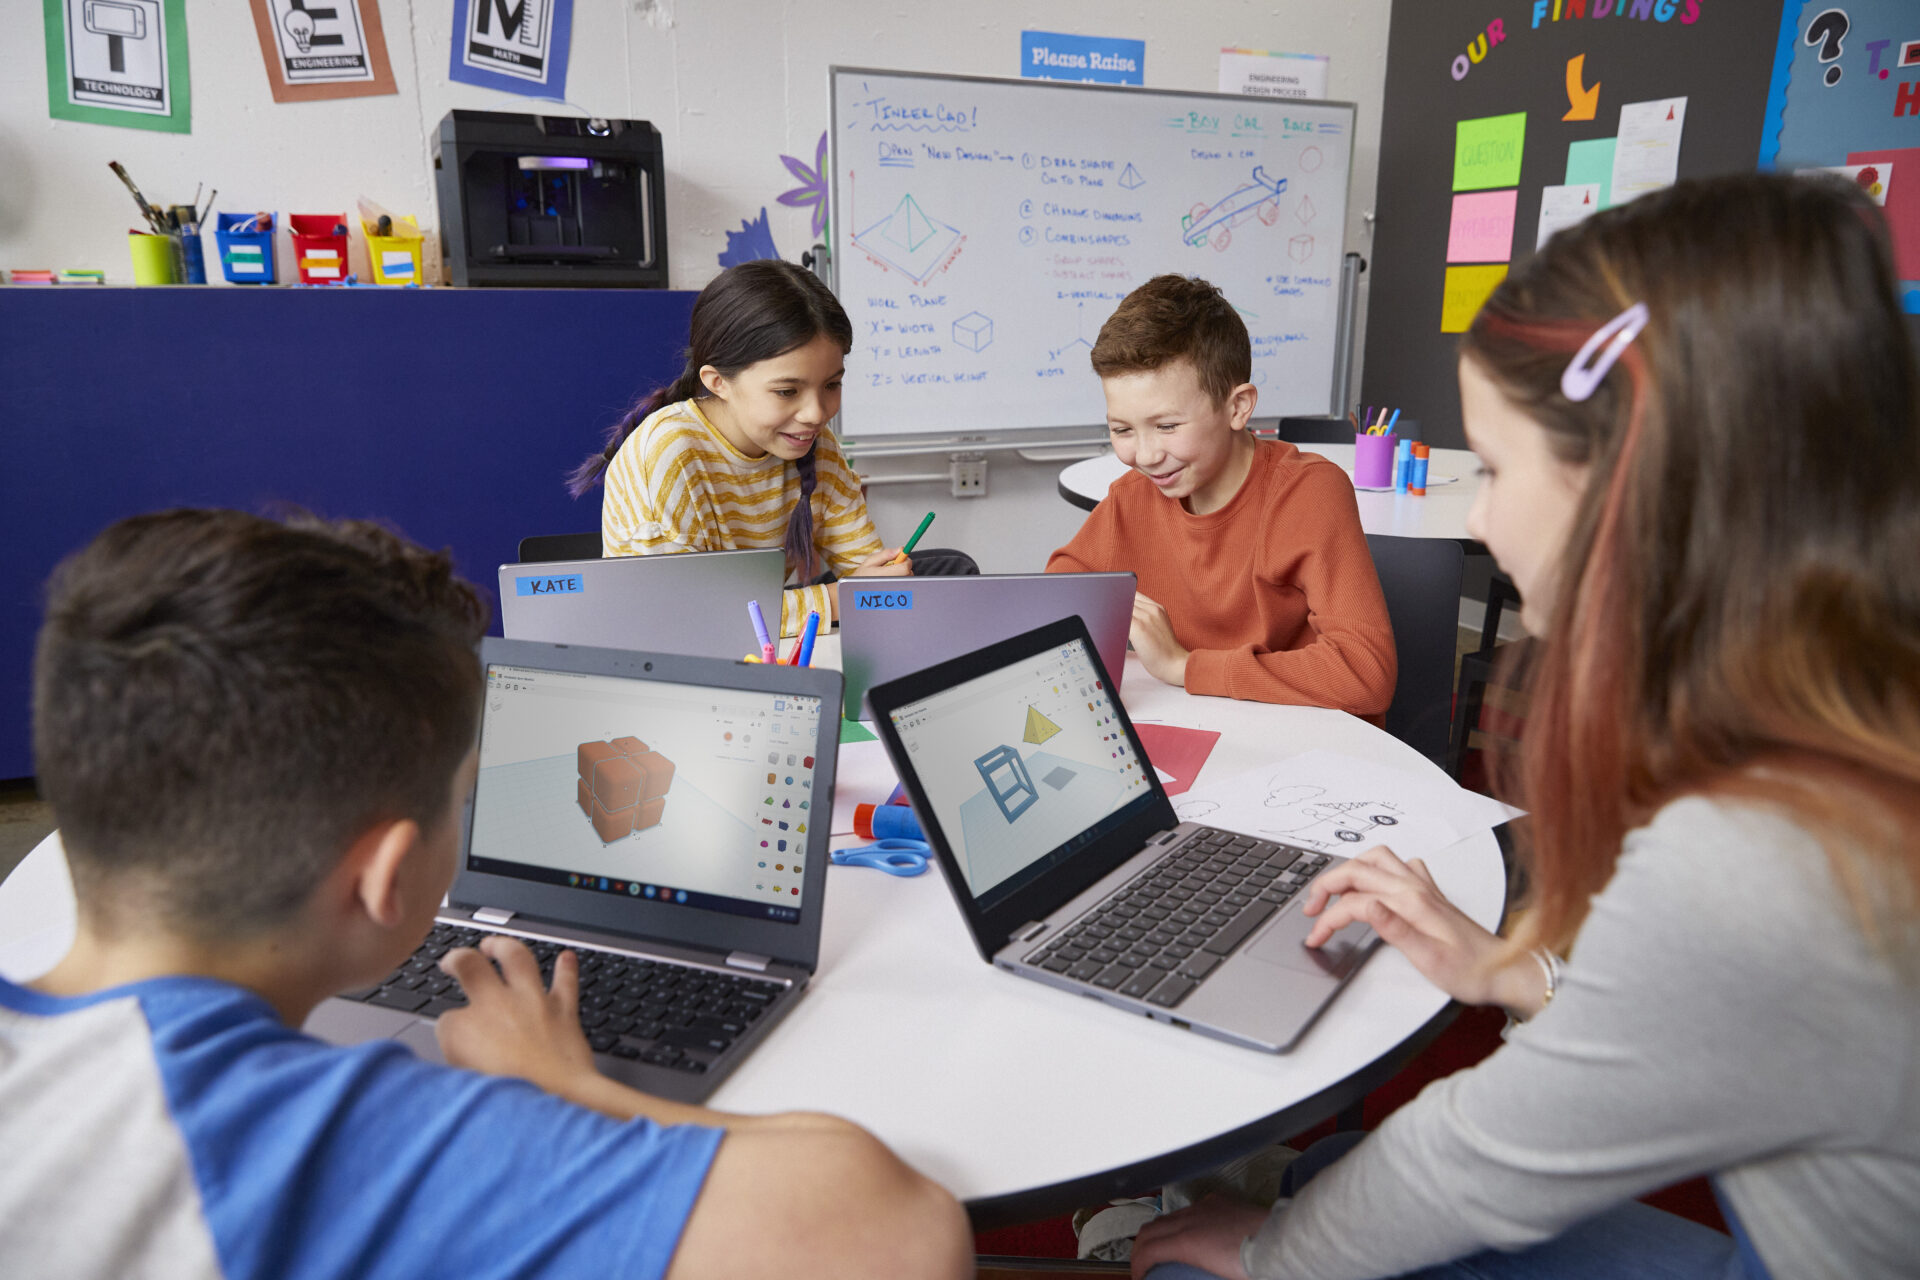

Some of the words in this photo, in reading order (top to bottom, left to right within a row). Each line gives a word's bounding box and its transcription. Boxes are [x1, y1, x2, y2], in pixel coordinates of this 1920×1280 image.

[1531, 0, 1700, 29] FINDINGS
[493, 48, 520, 63] MATH
[1451, 18, 1507, 81] OUR
[291, 57, 360, 70] ENGINEERING
[1032, 47, 1087, 69] Please
[1089, 52, 1137, 72] Raise
[1249, 74, 1300, 85] ENGINEERING
[82, 79, 160, 100] TECHNOLOGY
[1242, 85, 1271, 96] DESIGN
[1272, 87, 1308, 98] PROCESS
[1233, 113, 1264, 131] CAR
[1041, 155, 1077, 169] DRAG
[908, 294, 948, 307] PLANE
[531, 578, 578, 594] KATE
[859, 594, 909, 609] NICO
